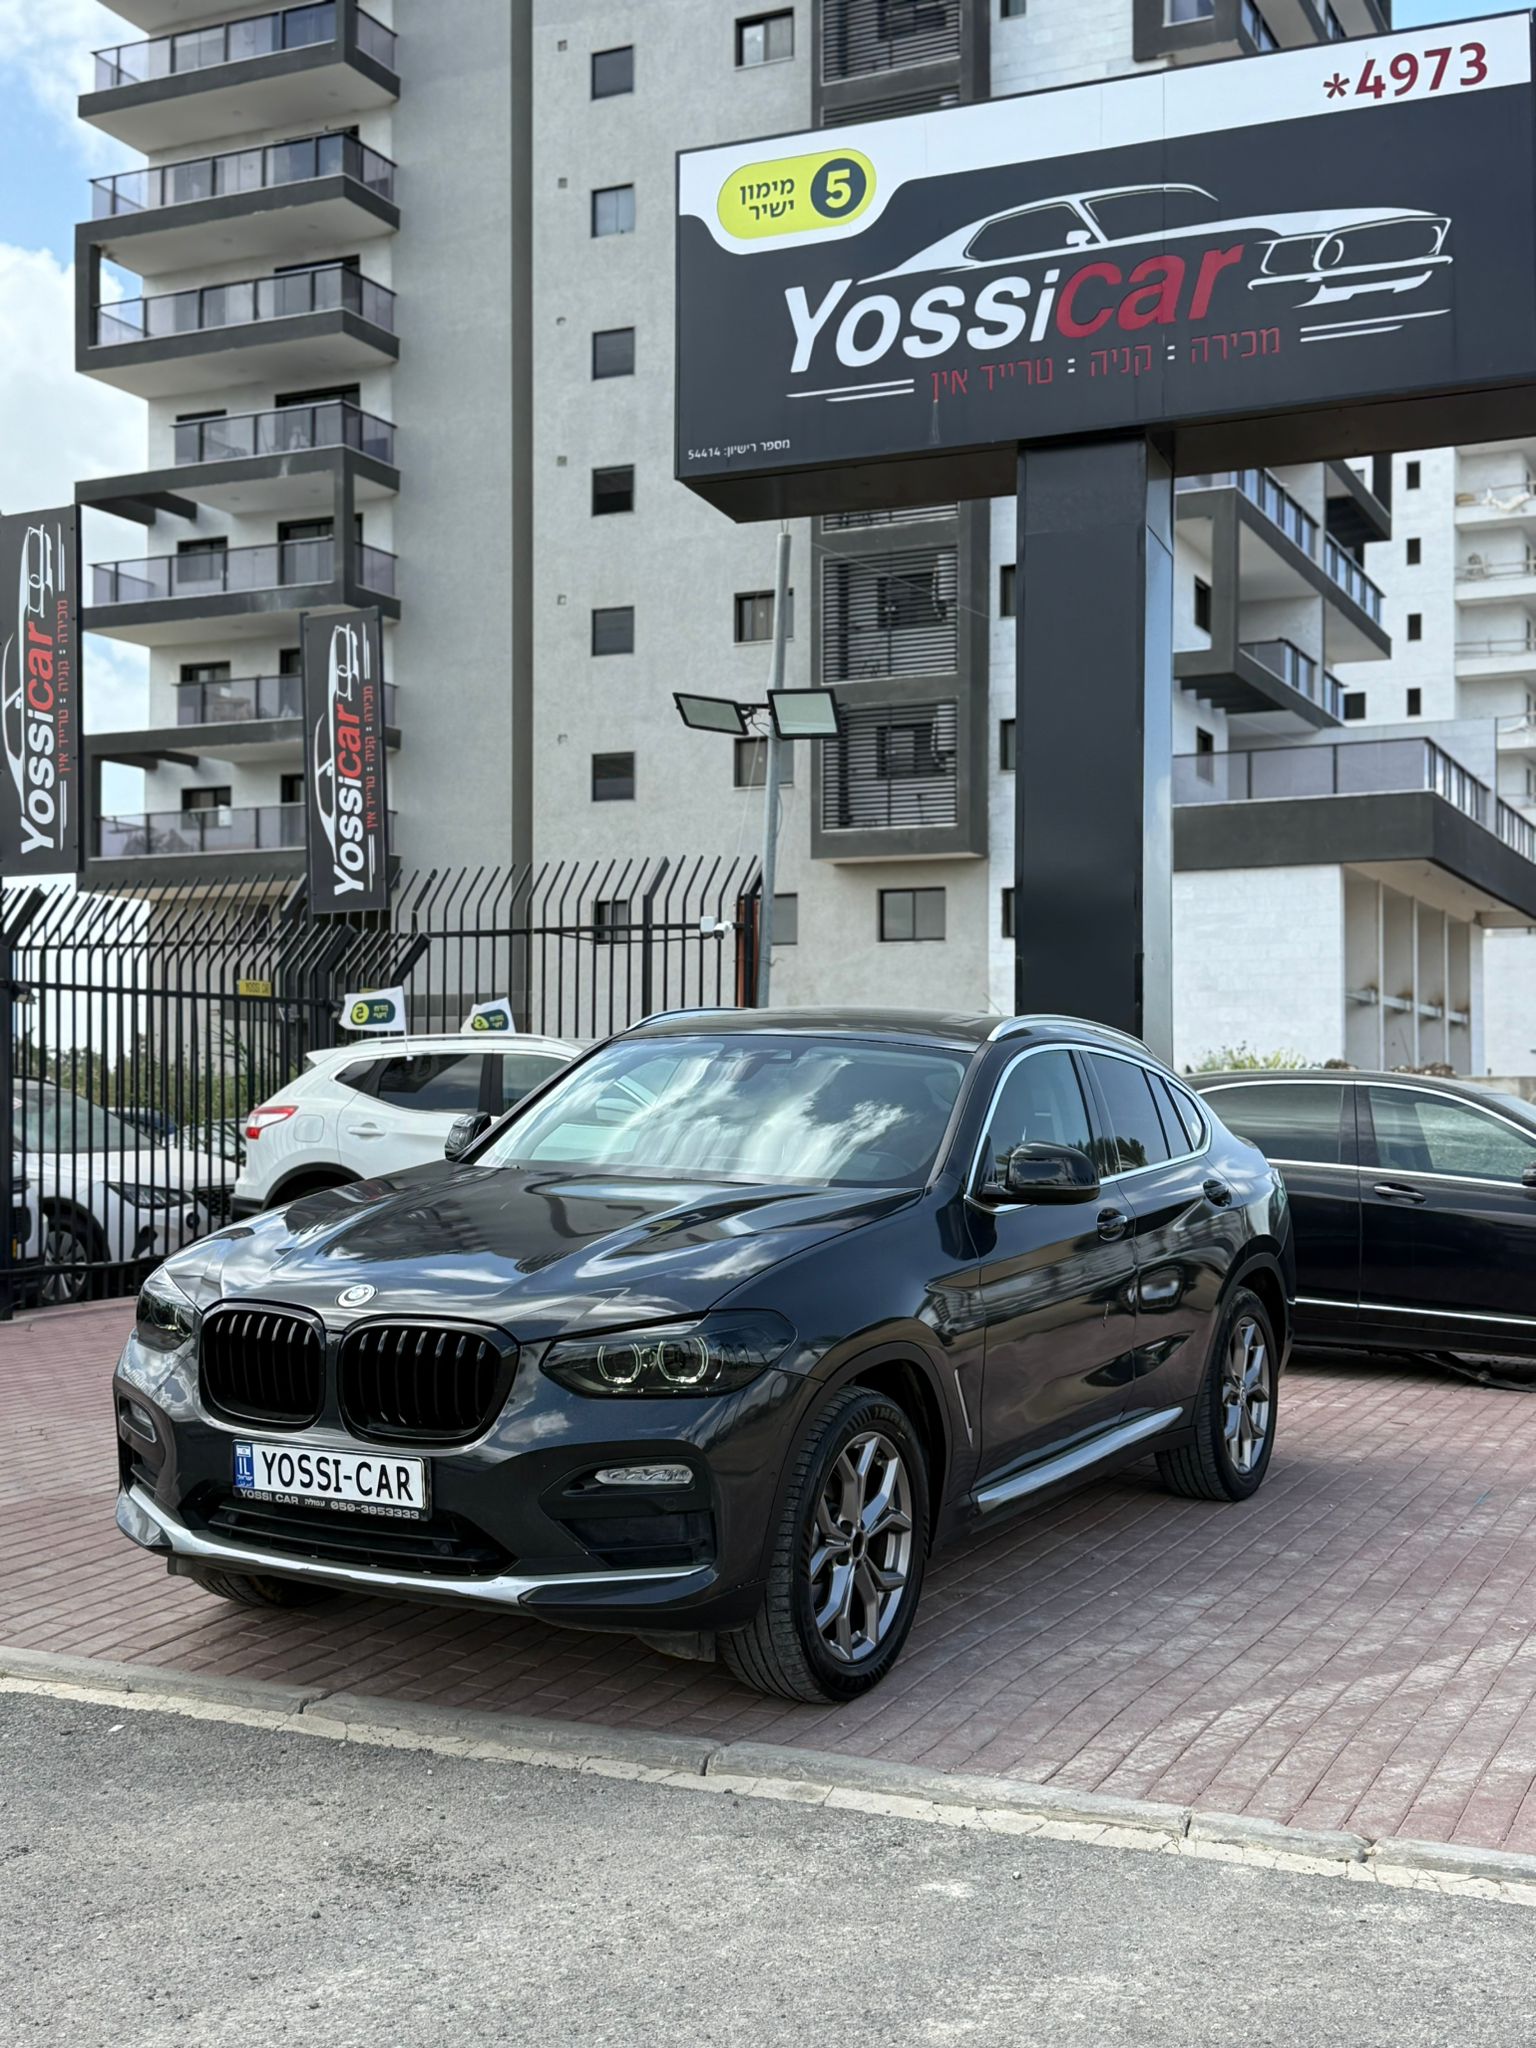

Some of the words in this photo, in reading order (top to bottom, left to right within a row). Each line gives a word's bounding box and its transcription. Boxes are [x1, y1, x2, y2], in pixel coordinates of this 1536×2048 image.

[739, 178, 795, 205] מימון
[825, 168, 852, 209] 5
[749, 199, 795, 221] ישיר
[1090, 344, 1152, 378] קניה
[1190, 327, 1281, 364] מכירה
[930, 368, 968, 402] אין
[979, 356, 1054, 391] טרייד
[688, 447, 721, 460] 54414
[723, 443, 757, 457] רישיון:
[760, 439, 791, 451] מספר
[57, 600, 68, 643] מכירה
[57, 660, 70, 692] קניה
[239, 1457, 251, 1475] IL
[261, 1451, 414, 1501] YOSSI-CAR
[240, 1488, 272, 1501] YOSSI
[275, 1494, 299, 1505] CAR
